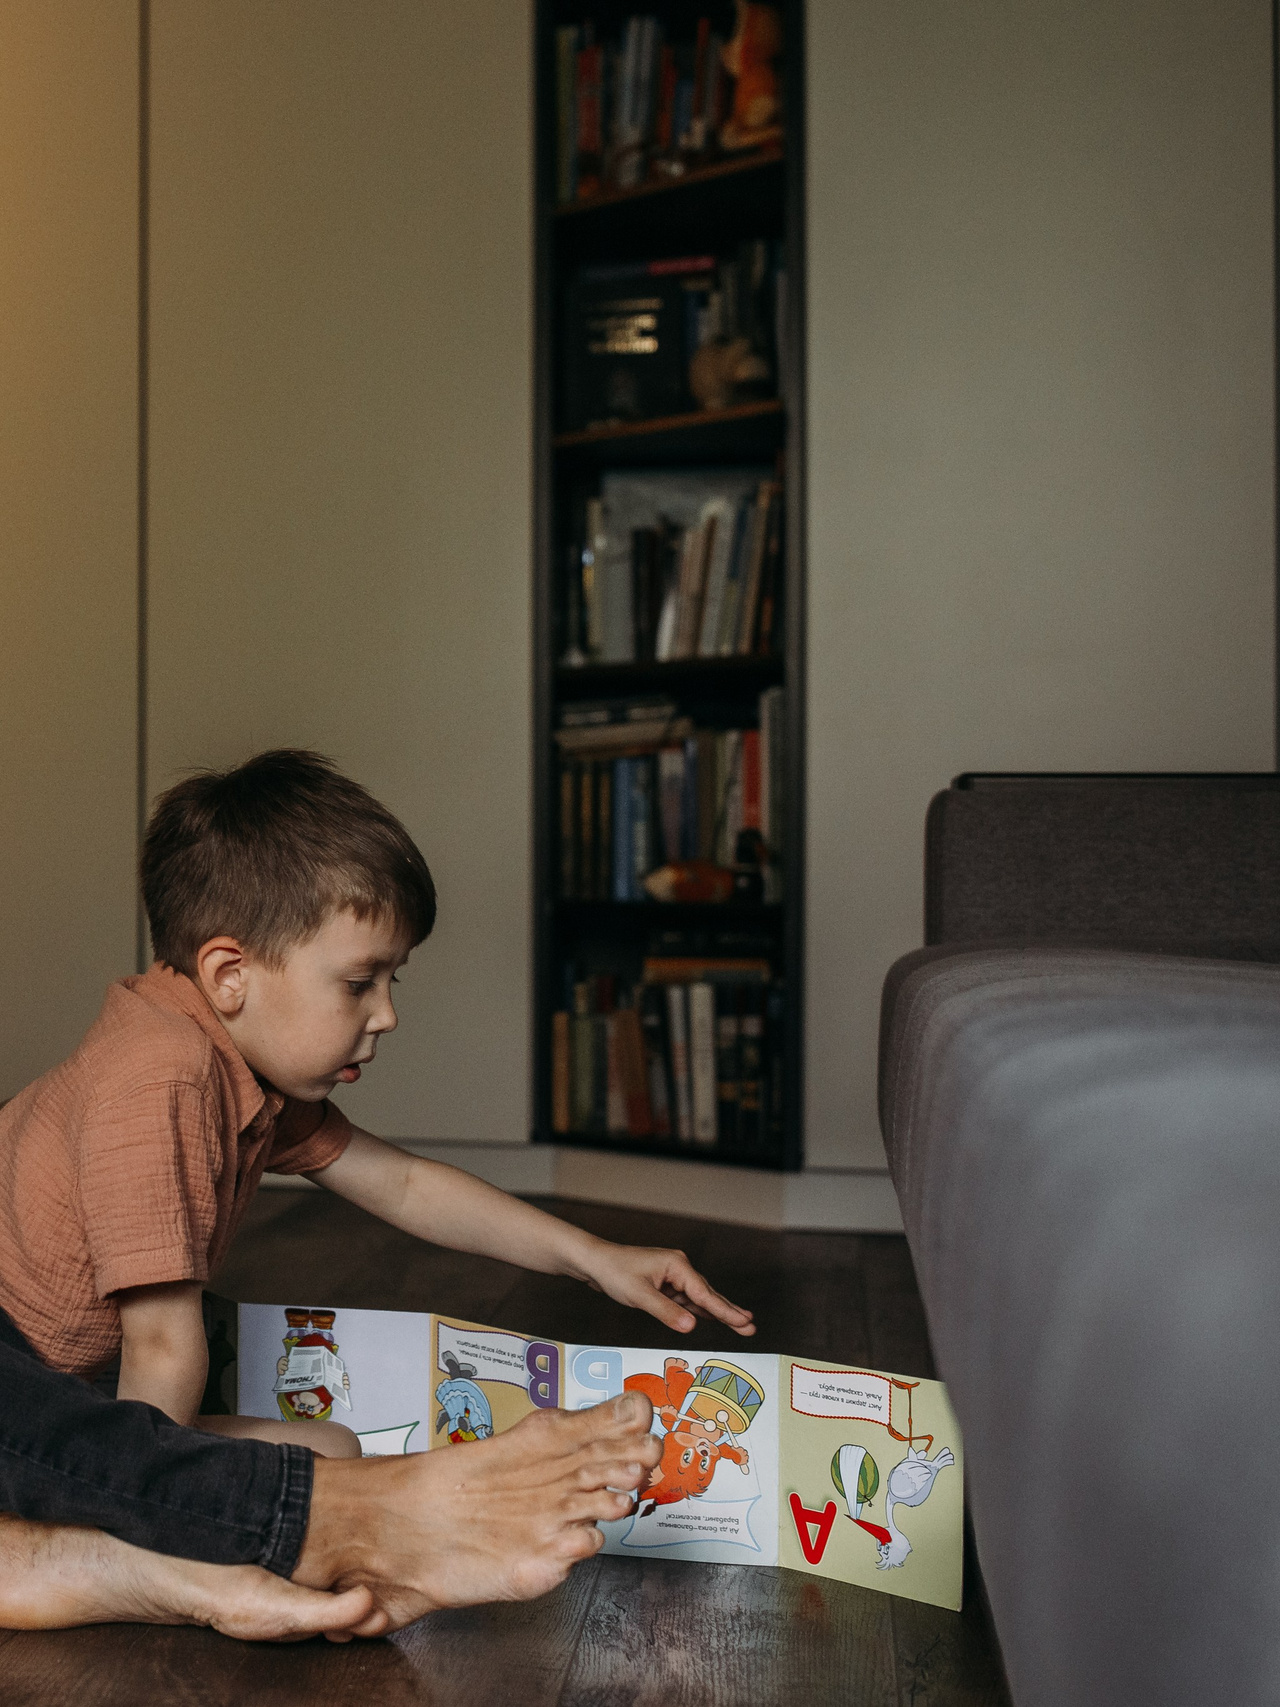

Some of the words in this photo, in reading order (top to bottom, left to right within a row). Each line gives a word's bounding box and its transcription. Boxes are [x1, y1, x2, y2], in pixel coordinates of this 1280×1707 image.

[525, 1341, 559, 1409] В
[285, 1376, 314, 1385] ГНОМА
[818, 1383, 835, 1391] арбуз.
[836, 1387, 863, 1396] сахарный
[865, 1392, 882, 1401] Алый,
[846, 1399, 866, 1407] держит
[868, 1403, 882, 1411] Аист
[703, 1516, 739, 1525] Барабанит,
[788, 1492, 838, 1565] А
